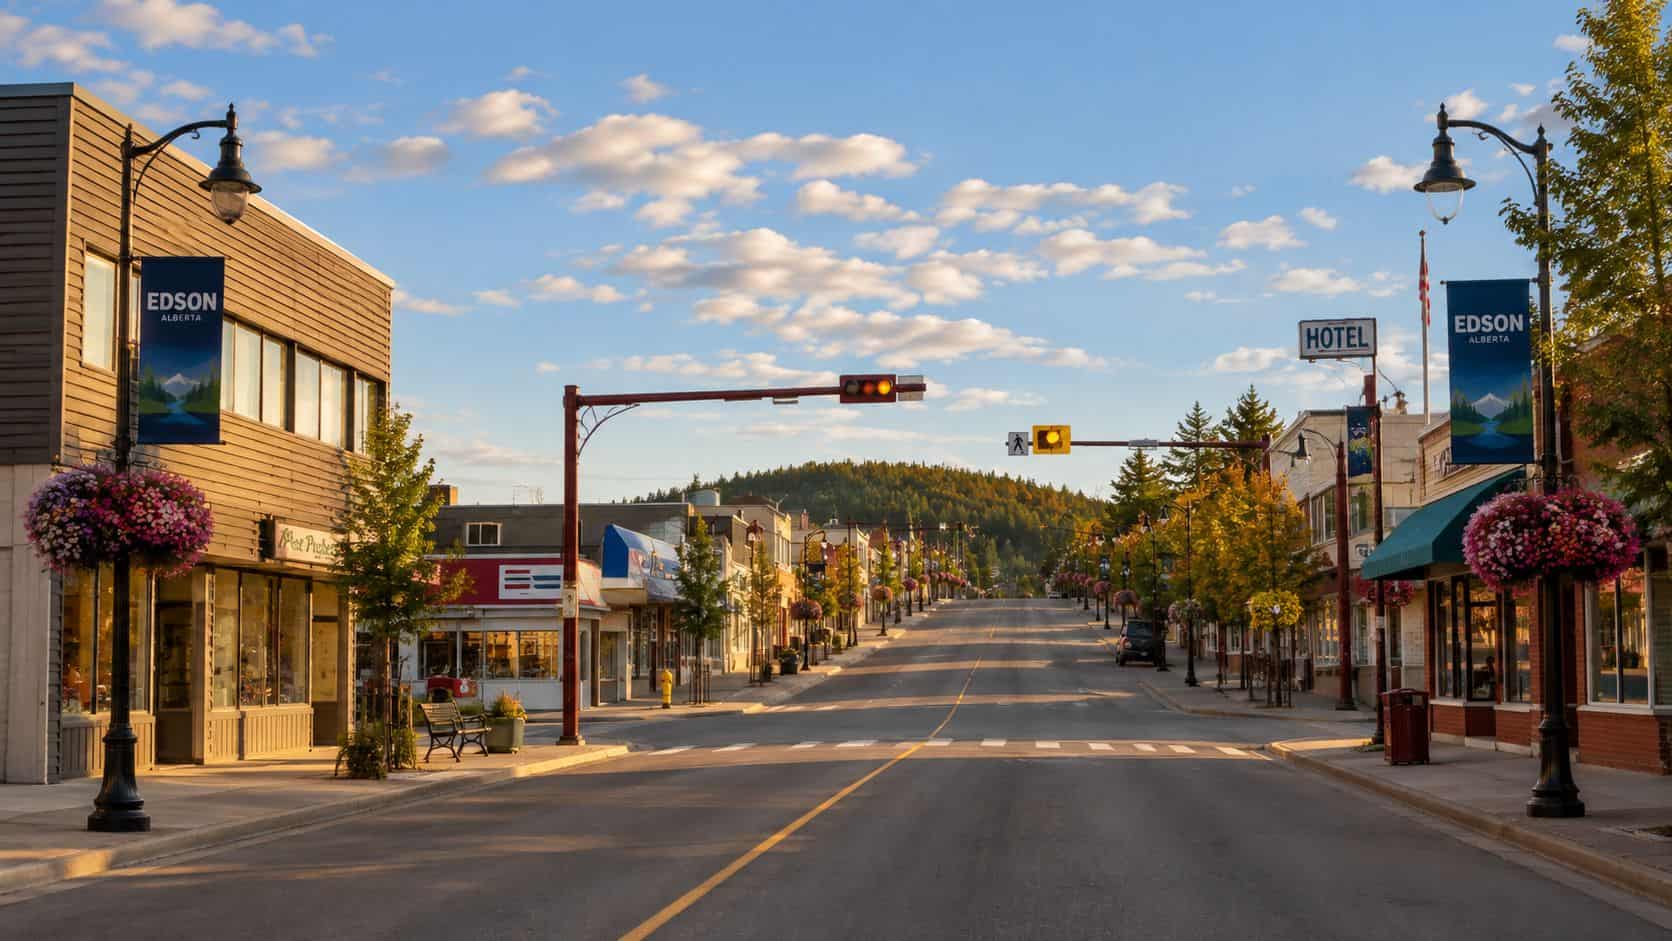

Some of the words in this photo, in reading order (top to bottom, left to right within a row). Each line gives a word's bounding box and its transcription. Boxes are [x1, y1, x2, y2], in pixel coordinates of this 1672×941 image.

[147, 292, 217, 311] EDSON
[161, 313, 201, 322] ALBERTA
[1455, 313, 1524, 333] EDSON
[1306, 325, 1369, 349] HOTEL
[1469, 335, 1510, 344] ALBERTA
